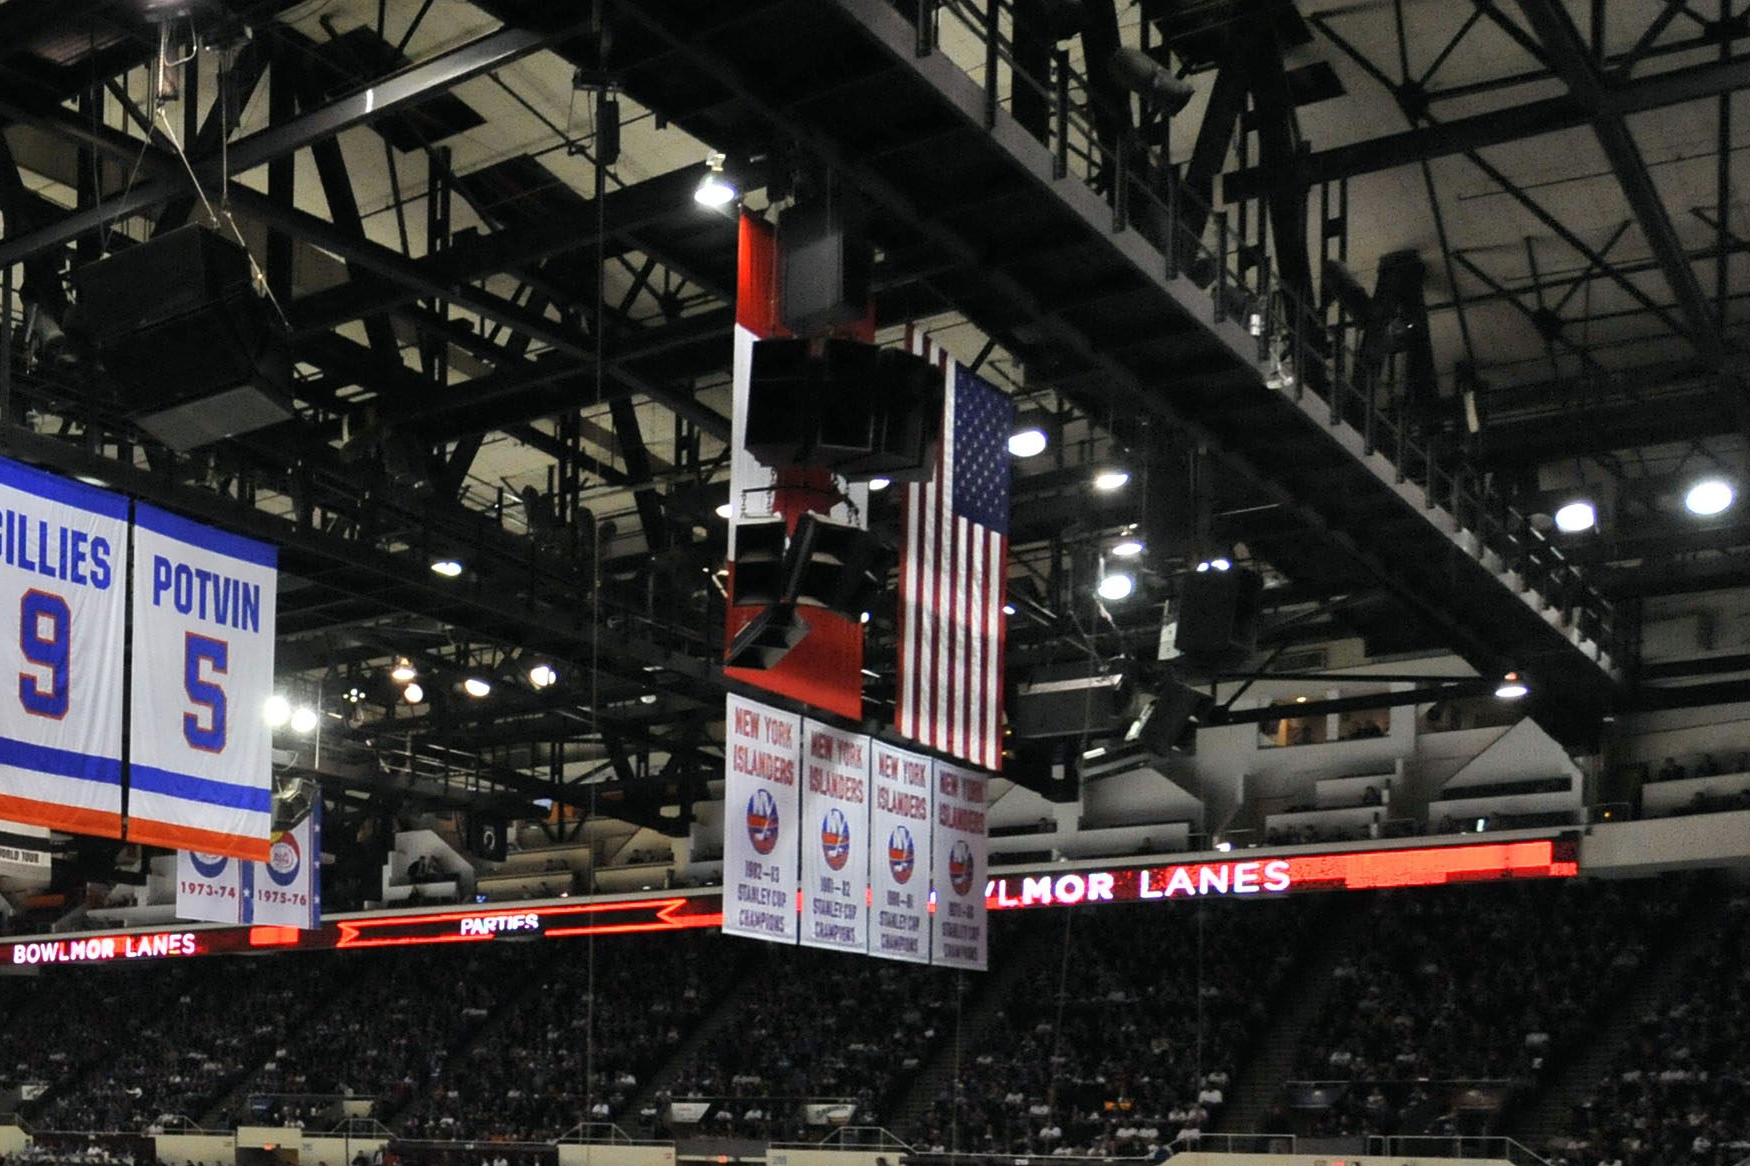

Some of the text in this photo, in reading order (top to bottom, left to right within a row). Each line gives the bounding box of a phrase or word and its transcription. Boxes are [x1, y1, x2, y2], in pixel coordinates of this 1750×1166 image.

[153, 556, 260, 634] POTVIN
[18, 589, 72, 720] 9
[183, 632, 228, 753] 5
[734, 707, 793, 749] NEW YORK
[733, 744, 795, 787] ISLANDERS
[810, 730, 863, 769] NEW YORK
[809, 765, 864, 804] ISLANDERS
[878, 754, 926, 788] NEW YORK
[877, 785, 927, 821] ISLANDERS
[181, 881, 236, 899] 1973-74
[258, 889, 307, 906] 1975-76
[737, 884, 787, 908] STANLEY CUP
[1140, 861, 1291, 900] LANES
[739, 909, 785, 934] CHAMPIONS
[13, 933, 195, 964] BOWLMOR LANES
